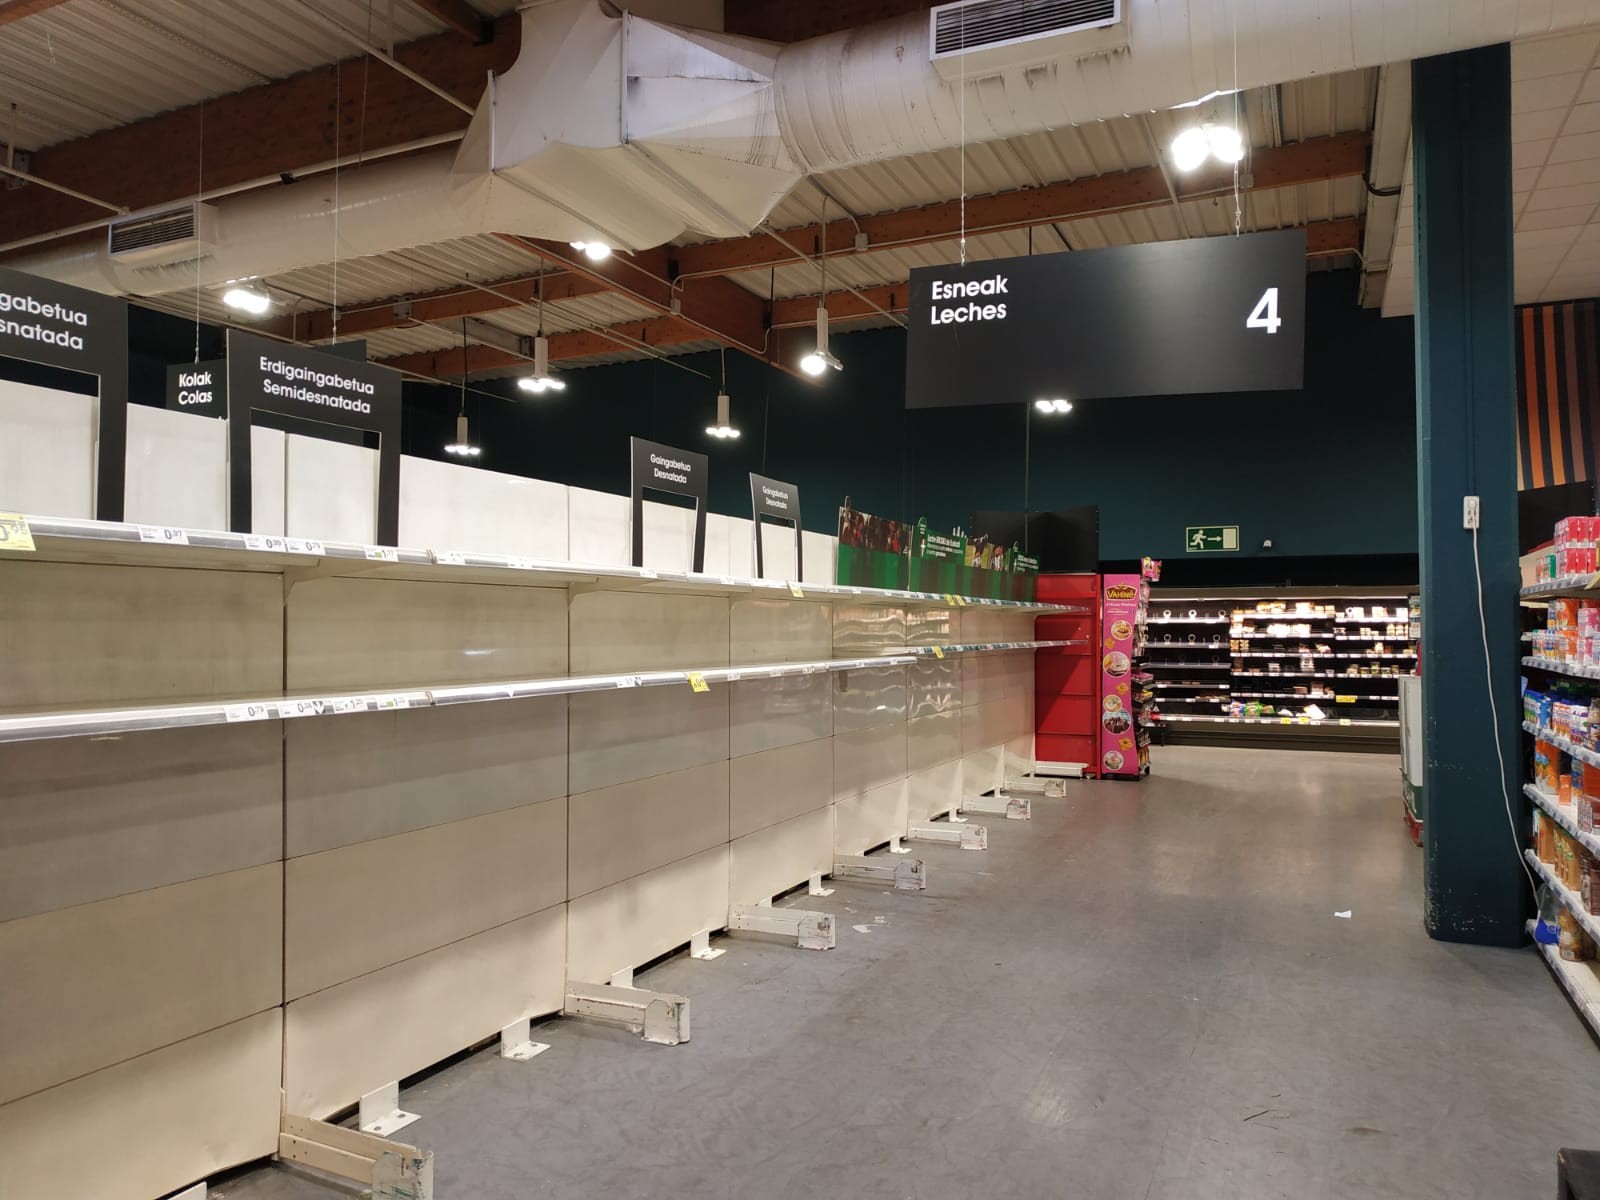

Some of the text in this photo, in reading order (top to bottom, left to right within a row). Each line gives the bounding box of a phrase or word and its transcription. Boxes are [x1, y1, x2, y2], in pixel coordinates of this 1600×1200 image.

[932, 274, 1009, 300] Esneak
[0, 292, 87, 326] gabetua
[931, 302, 1007, 325] Leches
[1246, 287, 1282, 334] 4
[178, 371, 212, 387] Kolak
[260, 356, 374, 394] Erdigaingabetua
[178, 390, 213, 405] Colas
[263, 378, 371, 414] Semidesnatada
[650, 454, 691, 472] Gaingabetua
[654, 468, 687, 484] Desnatada
